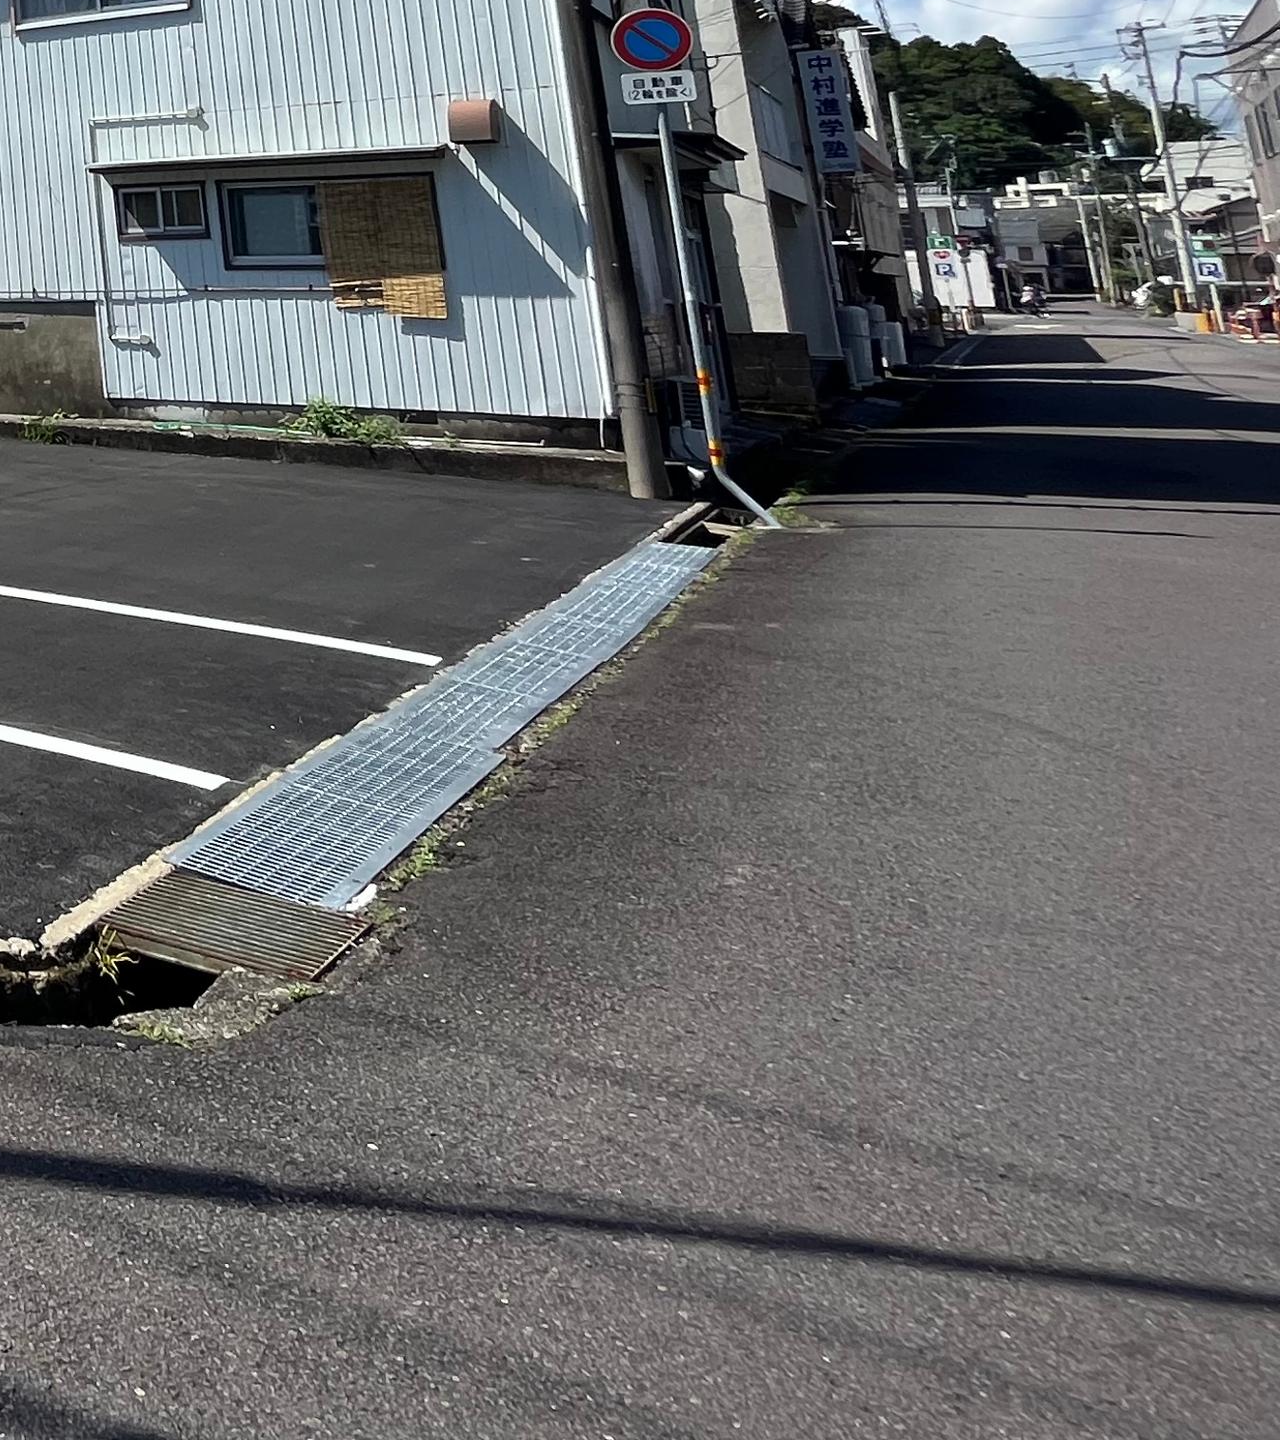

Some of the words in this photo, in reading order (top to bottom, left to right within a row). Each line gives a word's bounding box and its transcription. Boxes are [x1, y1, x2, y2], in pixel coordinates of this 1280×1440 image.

[633, 76, 683, 89] 自動車
[807, 55, 849, 158] 中村進学塾
